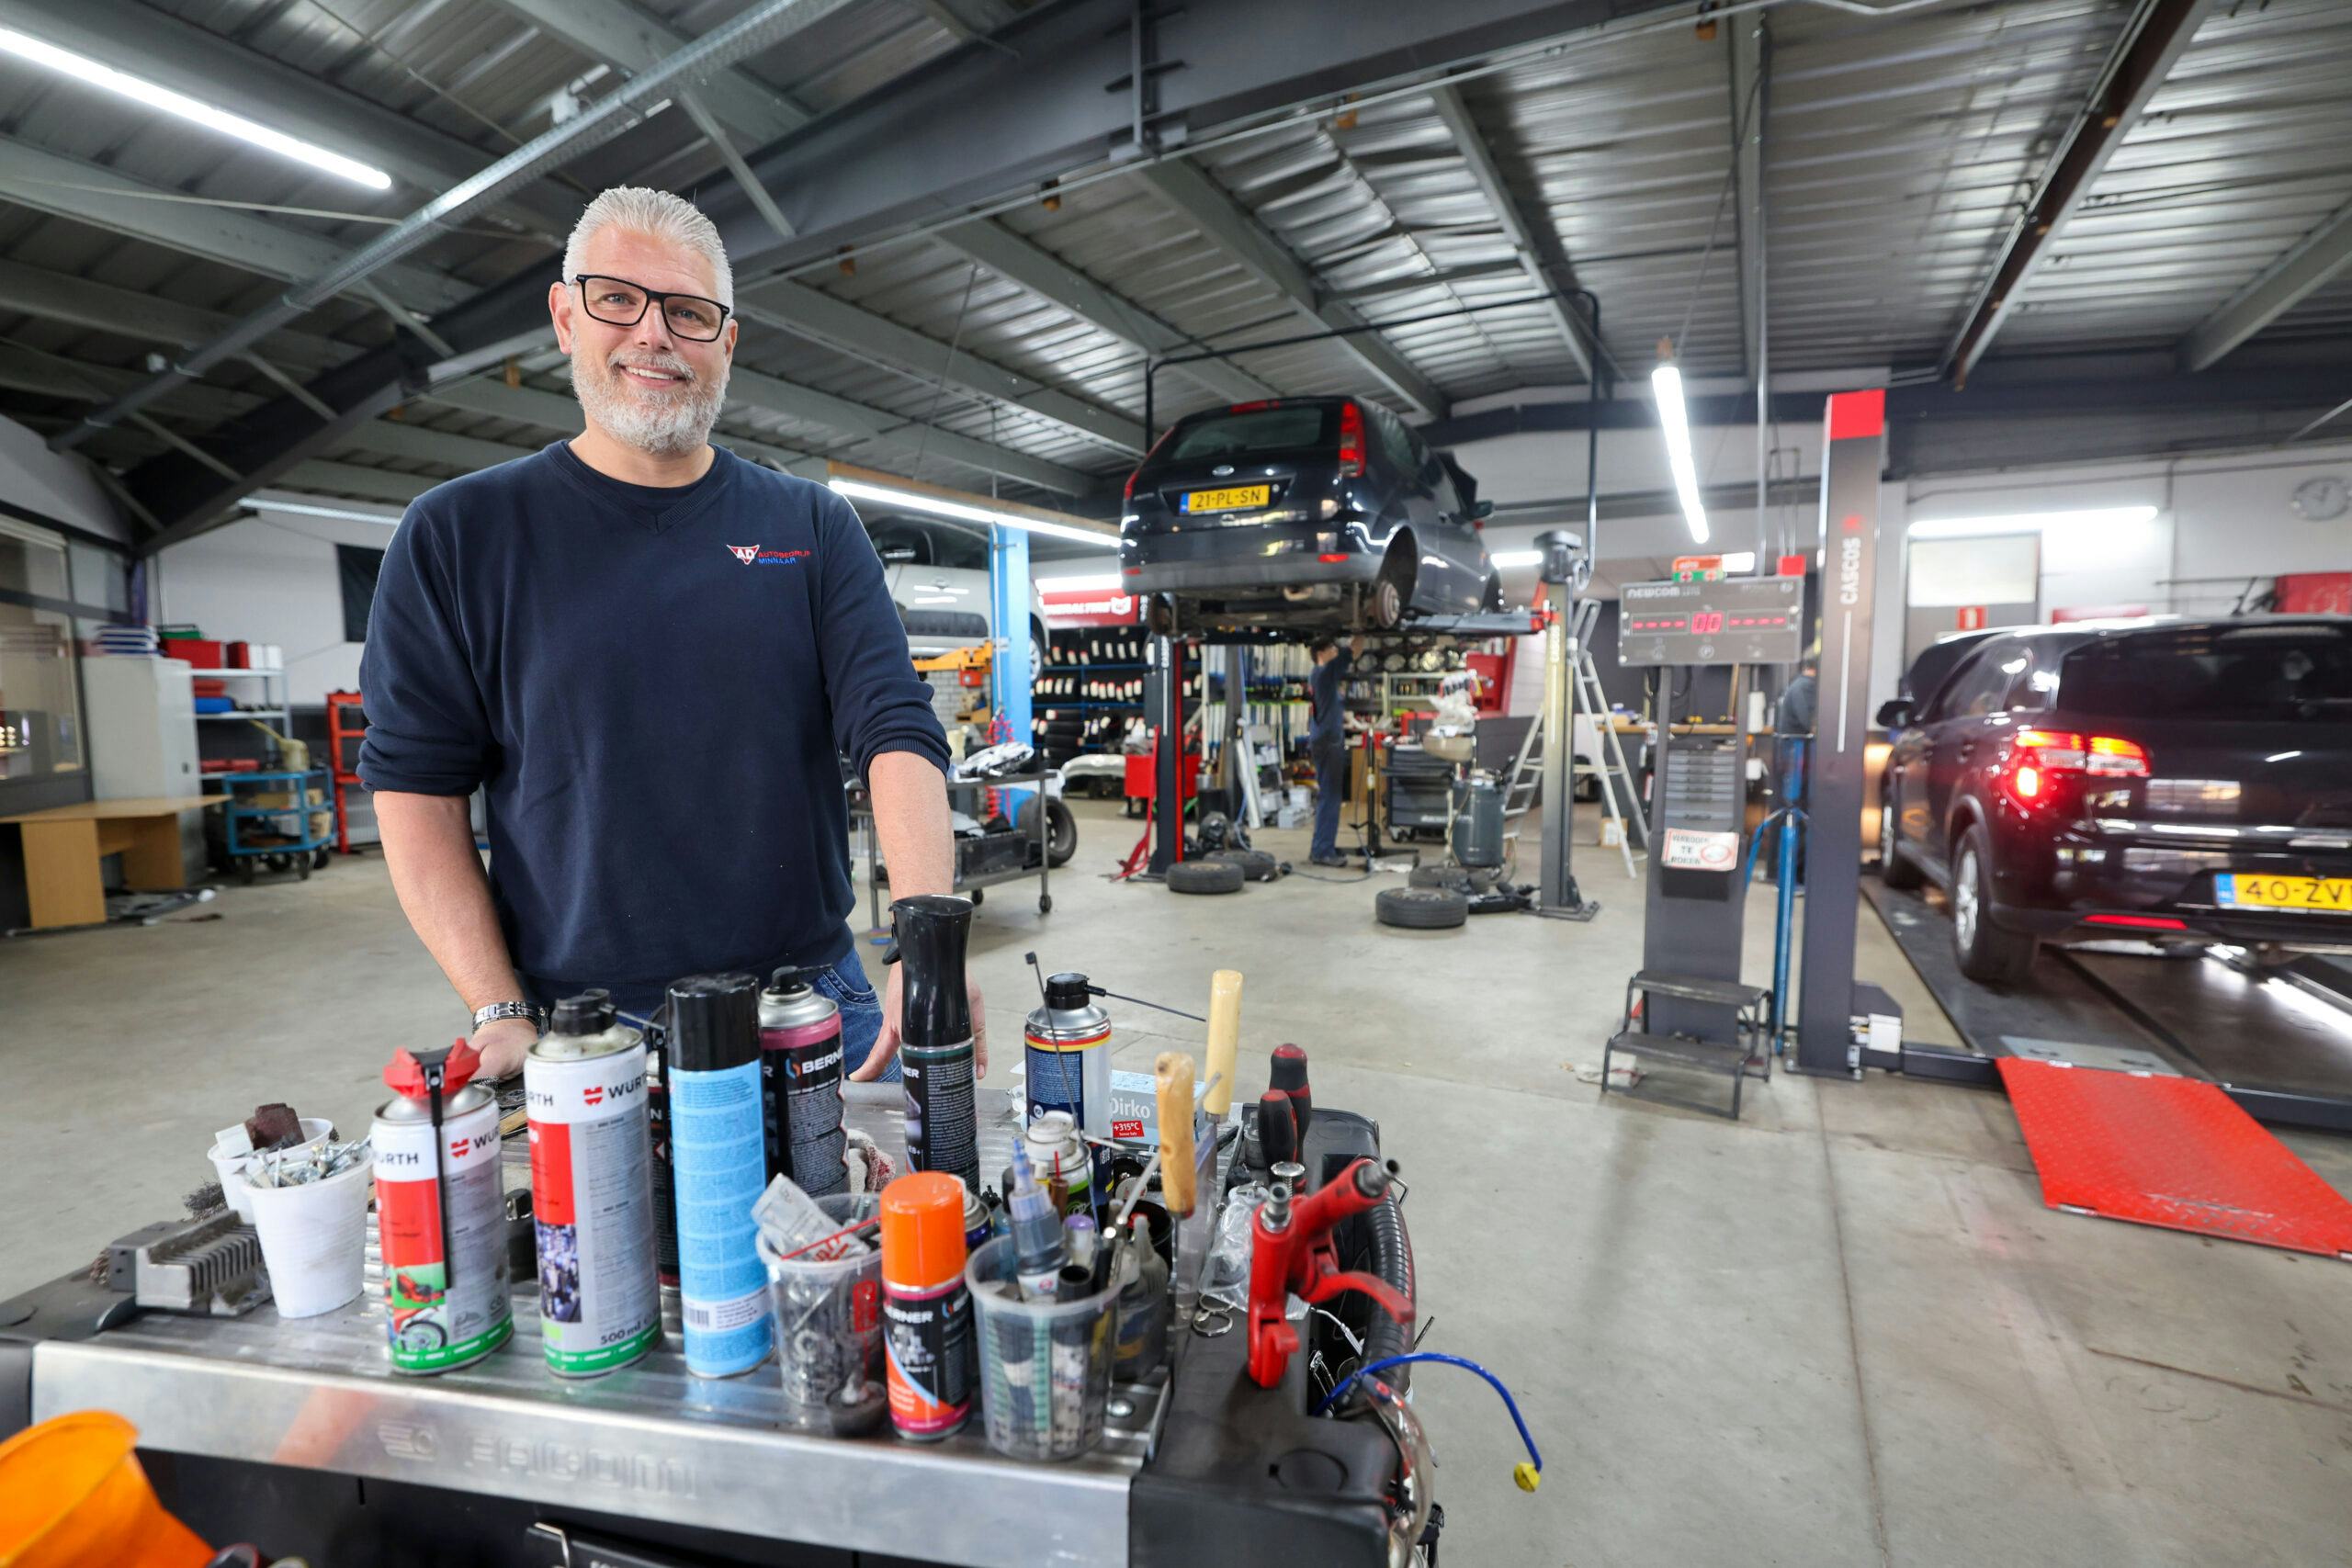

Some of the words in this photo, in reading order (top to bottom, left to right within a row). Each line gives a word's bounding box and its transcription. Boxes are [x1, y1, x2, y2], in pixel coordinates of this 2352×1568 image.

[1196, 489, 1261, 509] 21-PL-SN
[758, 557, 797, 565] MINNAAR
[1840, 537, 1861, 604] CASCOS
[2245, 880, 2352, 904] 40-ZV
[1111, 1097, 1151, 1119] Dirko
[600, 1328, 626, 1345] 500
